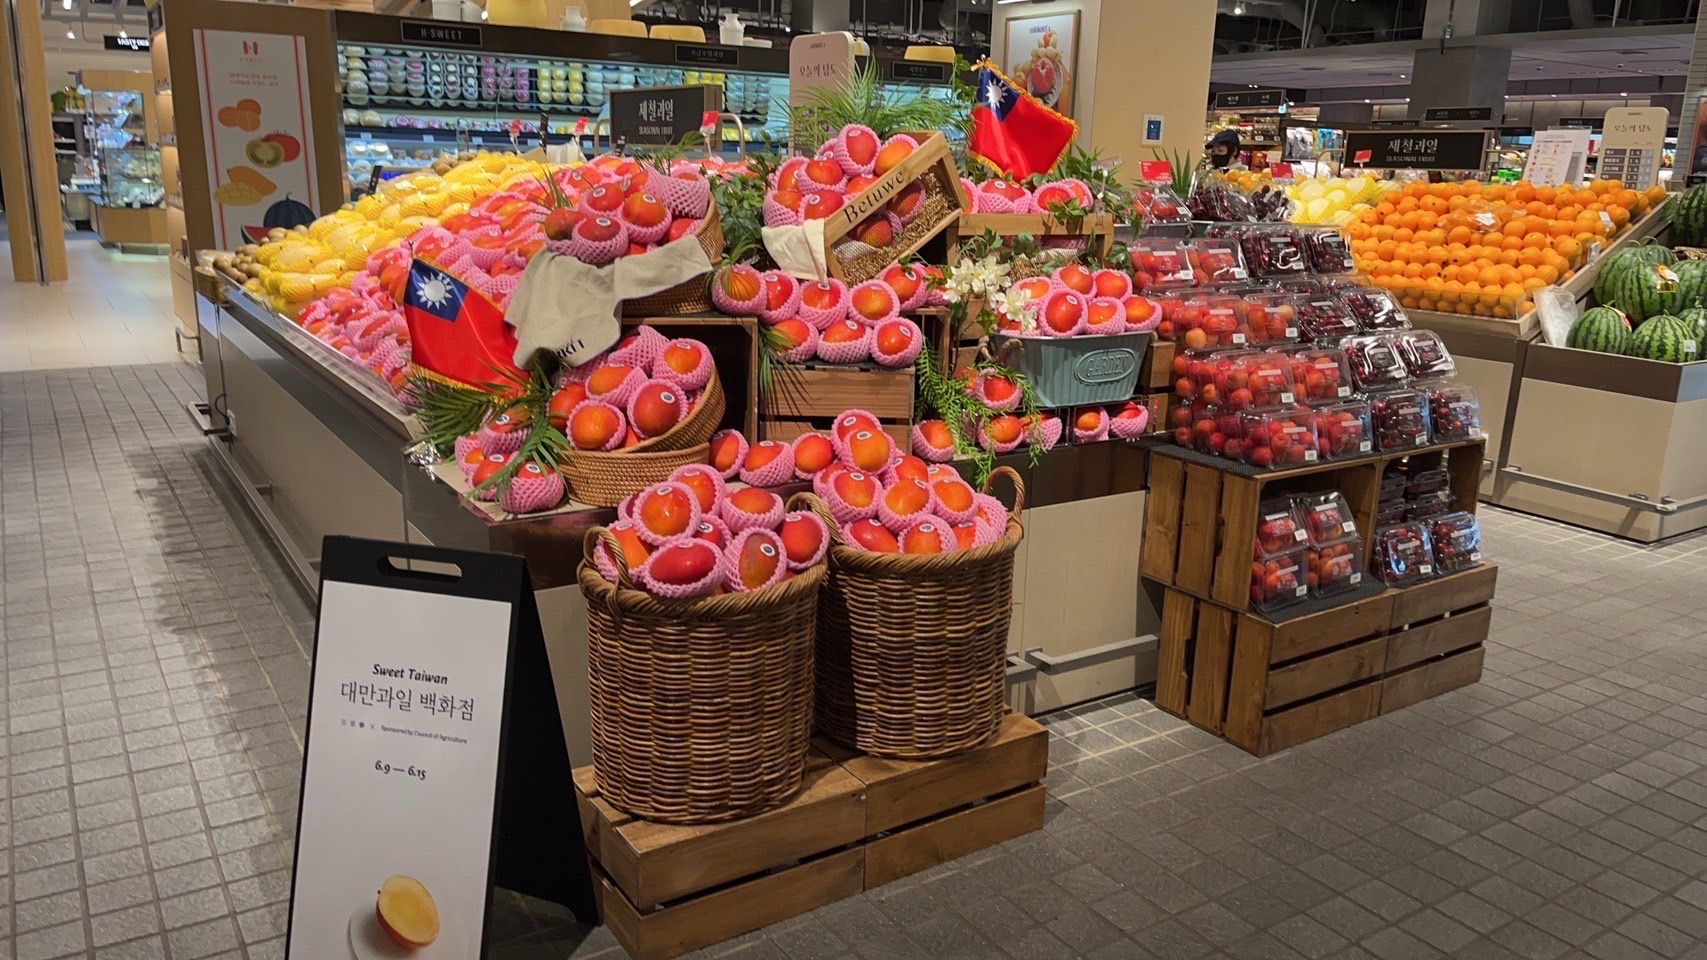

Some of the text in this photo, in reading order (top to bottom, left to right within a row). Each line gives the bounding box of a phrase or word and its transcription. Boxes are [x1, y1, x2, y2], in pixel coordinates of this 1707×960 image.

[639, 98, 674, 122] 제철과일
[1387, 138, 1439, 153] 제철과일
[843, 171, 906, 224] Betuwe
[372, 663, 449, 685] Sweet Taiwan
[341, 680, 474, 721] 대만과일 백화점
[374, 759, 391, 774] 6.9
[407, 765, 427, 781] 6.15
